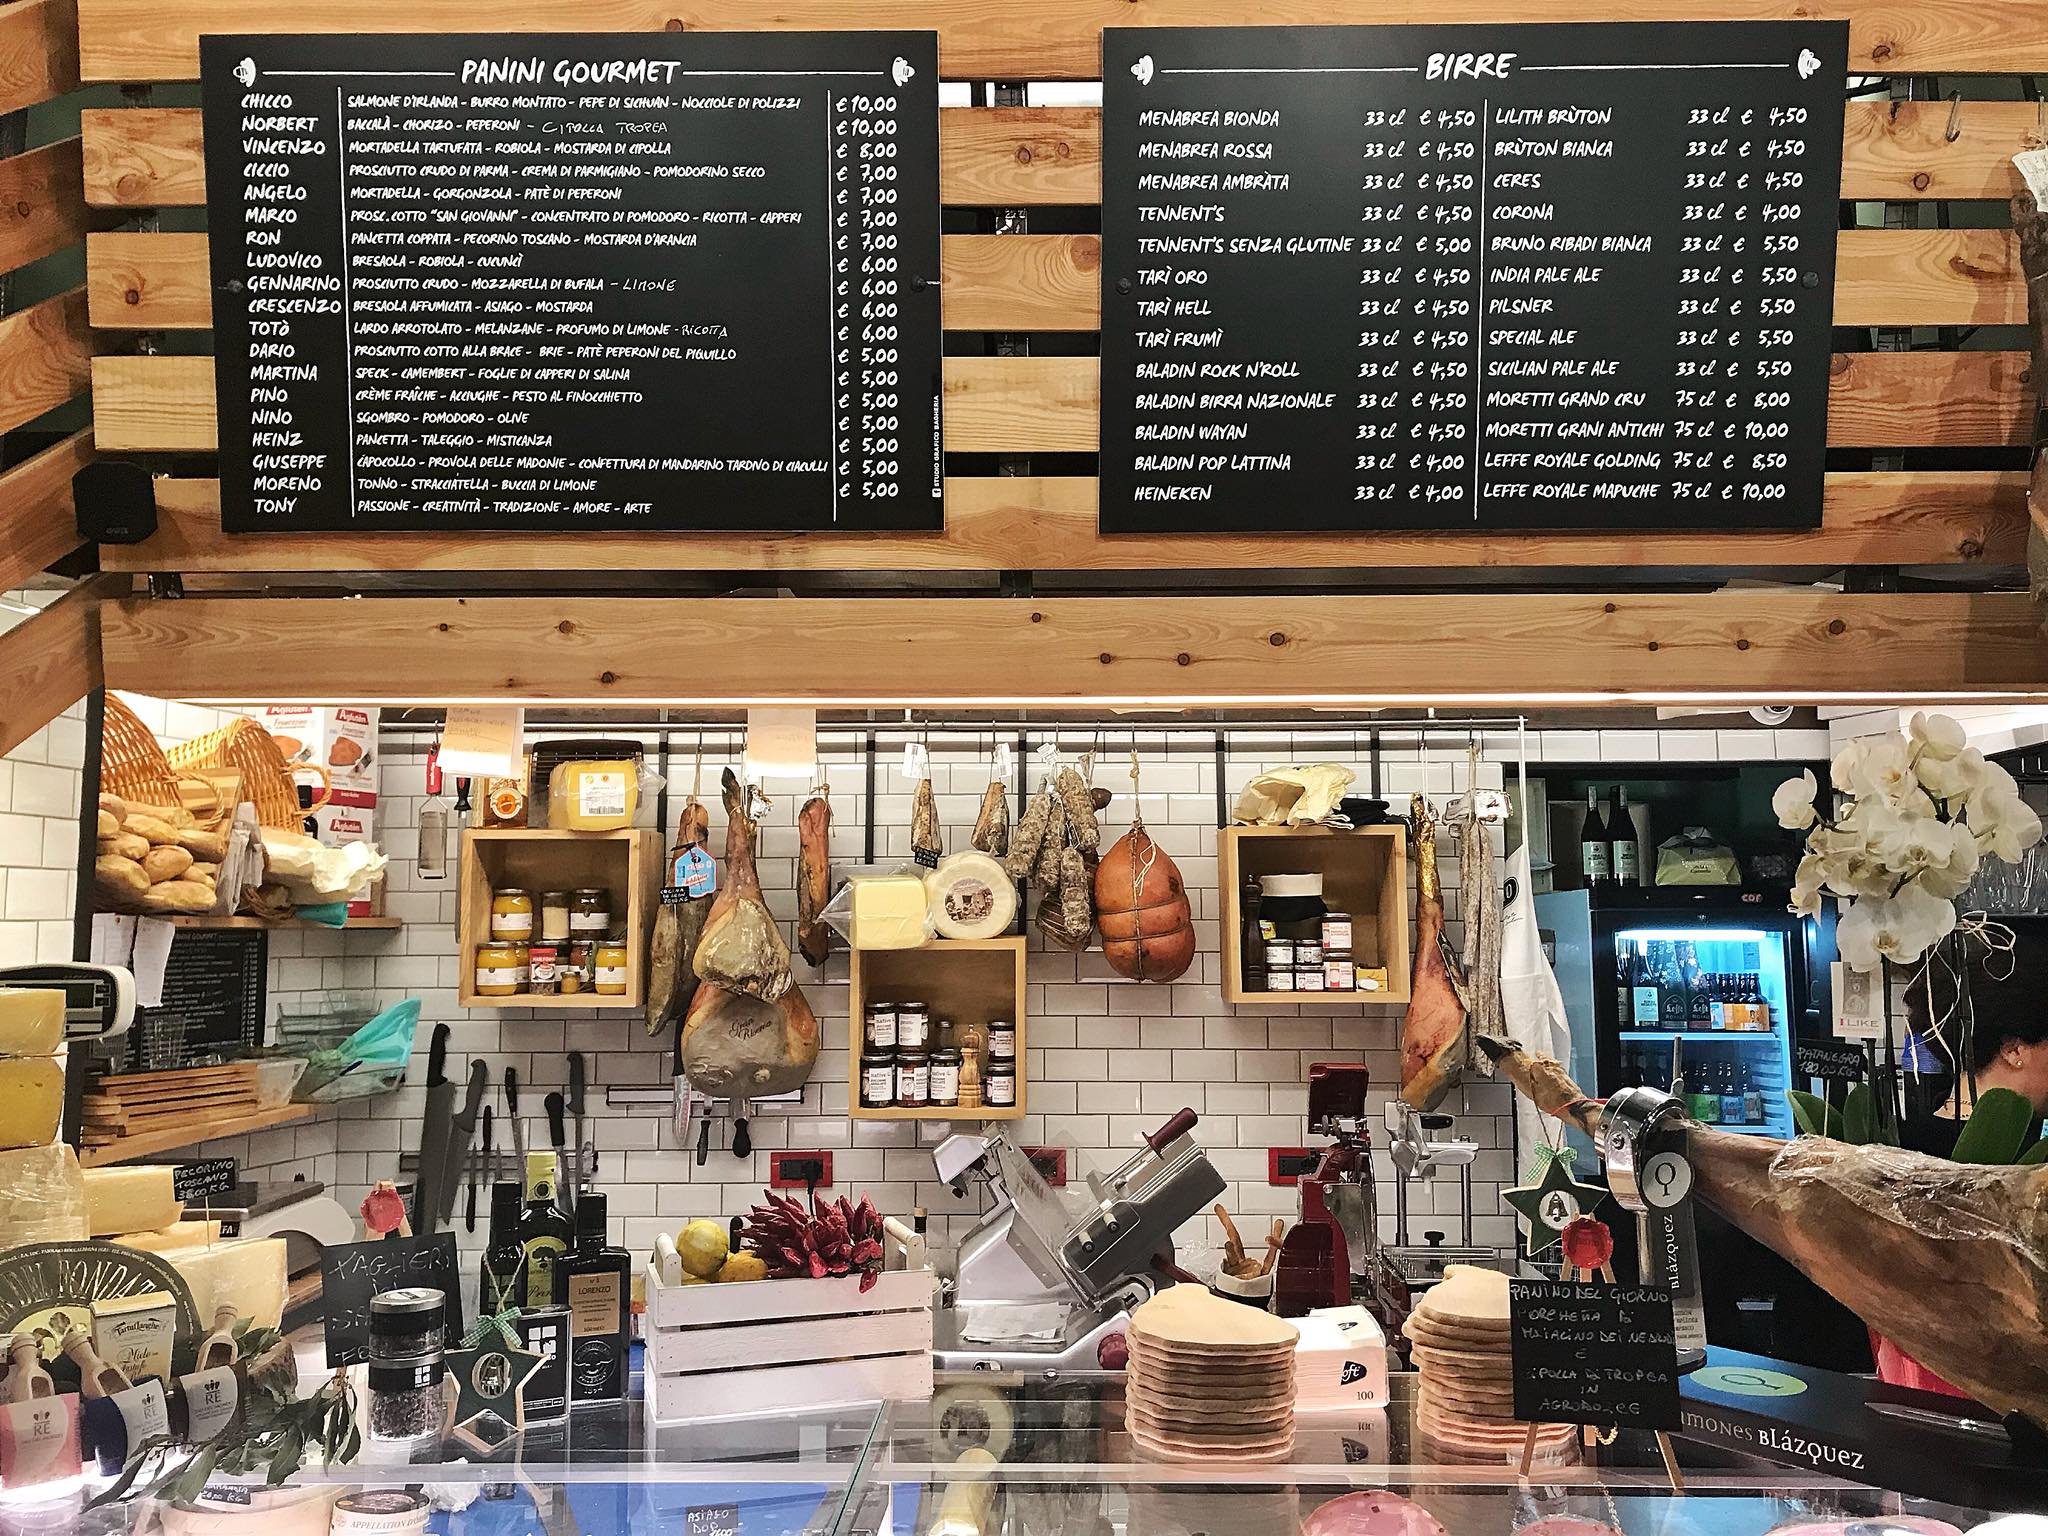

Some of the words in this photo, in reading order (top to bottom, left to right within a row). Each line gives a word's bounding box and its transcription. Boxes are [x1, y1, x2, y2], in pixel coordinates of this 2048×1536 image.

[461, 57, 545, 84] PANINI
[553, 59, 681, 86] GOURMET
[1425, 51, 1517, 81] BIRRE
[241, 93, 292, 108] CHICCO
[348, 94, 401, 107] SALMONE
[403, 95, 458, 108] D'IRLANDA
[471, 97, 509, 108] BURRO
[512, 95, 566, 108] MONTATO
[579, 97, 606, 108] PEPE
[609, 97, 620, 108] DI
[624, 96, 669, 108] SICHUAN
[682, 96, 736, 108] NOCCIOLE
[738, 98, 750, 108] DI
[752, 97, 800, 109] POLIZZI
[836, 97, 847, 112] €
[851, 95, 896, 114] 10,00
[347, 115, 390, 130] BACCALÀ
[403, 119, 453, 130] CHORIZO
[466, 118, 520, 131] PEPERONI
[1139, 109, 1219, 127] MENABREA
[1224, 109, 1279, 126] BIONDA
[1364, 111, 1384, 126] 33
[1419, 110, 1431, 125] €
[1438, 110, 1475, 129] 4,50
[1496, 108, 1543, 124] LILITH
[1548, 105, 1611, 124] BRÙTON
[242, 115, 318, 132] NORBERT
[243, 137, 325, 154] VINCENZO
[244, 163, 289, 177] CICCIO
[1494, 174, 1541, 188] CERES
[244, 184, 307, 202] ANGELO
[246, 207, 297, 223] MARCO
[1493, 203, 1553, 220] CORONA
[246, 229, 280, 245] RON
[1229, 236, 1281, 253] SENZA
[1286, 236, 1355, 255] GLUTINE
[1491, 235, 1545, 251] BRUNO
[1550, 236, 1597, 252] RIBADI
[1602, 235, 1651, 252] BIANCA
[247, 251, 322, 268] LUDOVICO
[247, 274, 340, 293] GENNARINO
[249, 297, 341, 313] CRESCENZO
[1137, 297, 1172, 316] TARÌ
[1175, 300, 1211, 316] HELL
[1489, 297, 1553, 314] PILSNER
[250, 343, 295, 358] DARIO
[251, 364, 317, 381] MARTINA
[1136, 362, 1196, 379] BALADIN
[1200, 364, 1242, 377] ROCK
[1488, 359, 1547, 376] SICILIAN
[1552, 360, 1588, 376] PALE
[1591, 360, 1619, 376] ALE
[251, 386, 287, 402] PINO
[1487, 391, 1554, 407] MORETTI
[1559, 390, 1609, 408] GRAND
[1614, 392, 1646, 406] CRU
[1676, 390, 1696, 407] 75
[1726, 393, 1736, 407] €
[1754, 392, 1790, 409] 8,00
[252, 409, 292, 424] NINO
[356, 412, 410, 424] SGOMBRO
[423, 412, 484, 423] POMODORO
[498, 412, 529, 424] OLIVE
[253, 431, 303, 447] HEINZ
[356, 433, 408, 445] PANCETTA
[421, 434, 474, 447] TALEGGIO
[487, 434, 552, 446] MISTICANZA
[253, 454, 326, 471] GIUSEPPE
[254, 475, 321, 491] MORENO
[1484, 483, 1530, 497] LEFFE
[1533, 483, 1590, 499] ROYALE
[1593, 483, 1661, 498] MAPUCHE
[1672, 482, 1692, 498] 75
[1722, 485, 1732, 499] €
[1743, 483, 1785, 501] 10,00
[1135, 485, 1212, 501] HEINEKEN
[254, 497, 297, 513] TONY
[358, 499, 410, 511] PASSIONE
[423, 498, 480, 512] CREATIVITÀ
[493, 501, 561, 512] TRADIZIONE
[573, 502, 612, 513] AMORE
[624, 503, 652, 514] ARTE
[174, 1161, 233, 1179] PECORINO
[175, 1173, 227, 1188] TOSCANO
[578, 1286, 612, 1295] LORENZO
[1357, 1391, 1374, 1400] 100
